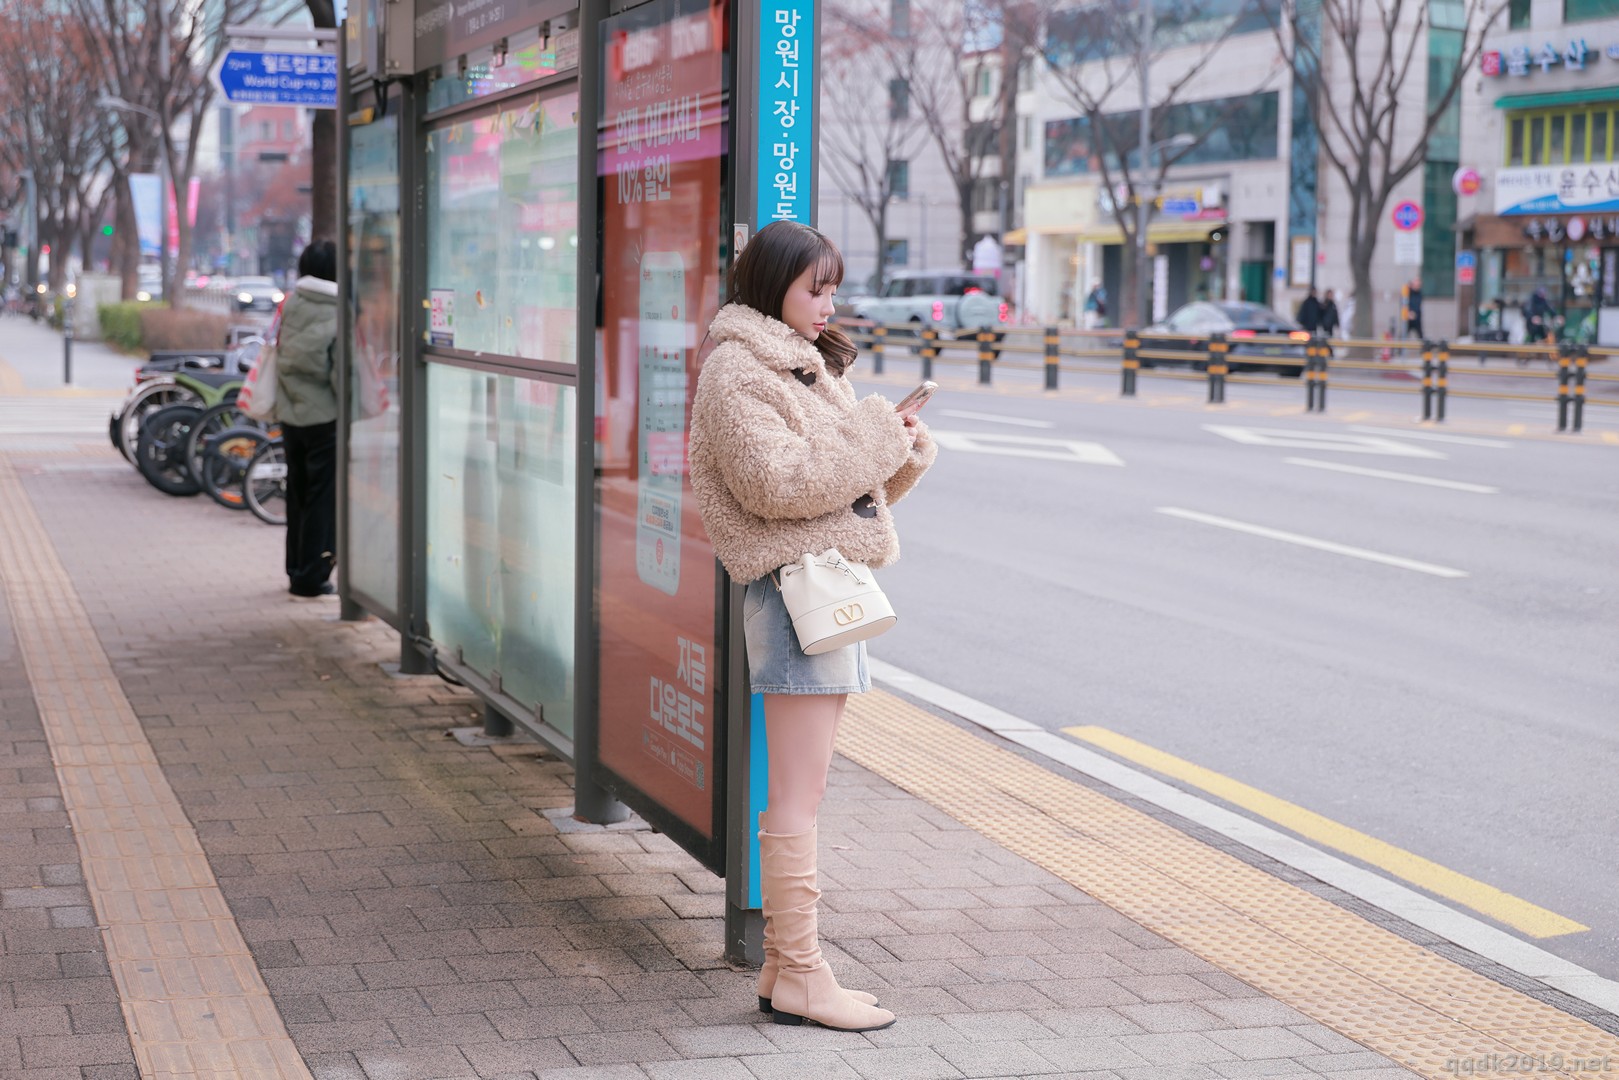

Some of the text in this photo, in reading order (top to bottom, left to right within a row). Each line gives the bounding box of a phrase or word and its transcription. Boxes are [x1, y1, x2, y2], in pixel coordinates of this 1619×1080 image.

[243, 75, 279, 88] World
[279, 75, 320, 91] Cup-ro
[645, 93, 702, 148] 어디서나
[616, 154, 671, 204] 10% 할인
[676, 636, 706, 696] 지금
[650, 676, 705, 751] 다운로드
